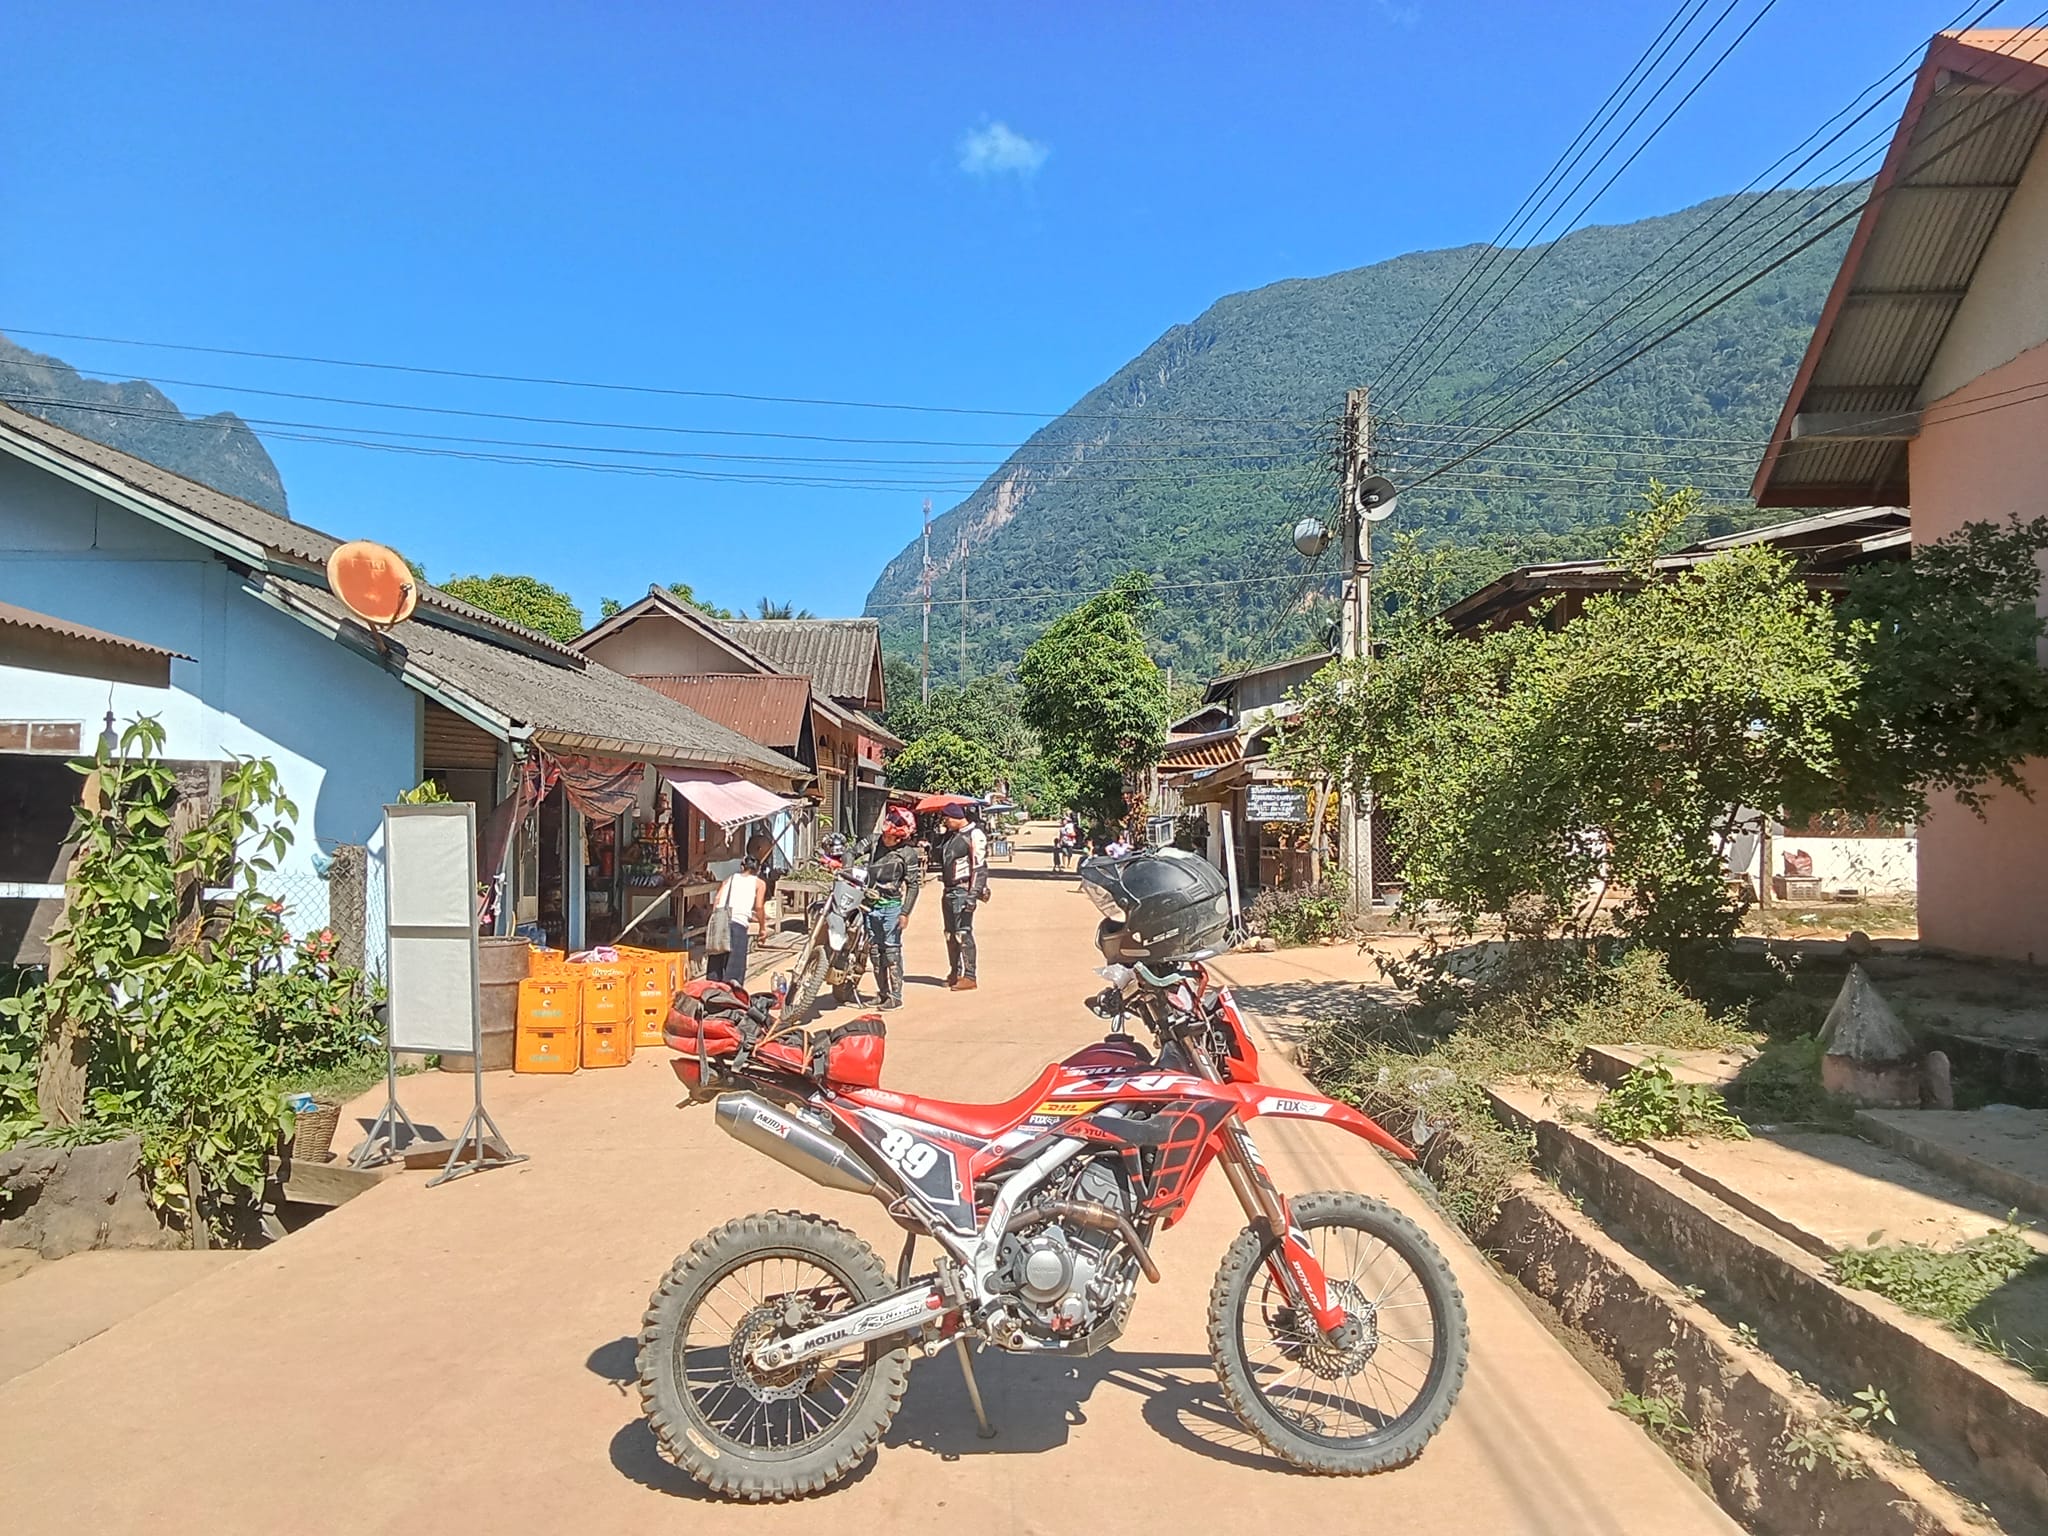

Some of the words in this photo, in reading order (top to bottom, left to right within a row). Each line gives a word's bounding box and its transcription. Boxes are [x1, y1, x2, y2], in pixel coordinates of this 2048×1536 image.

[1051, 1075, 1203, 1095] CRF
[1047, 1104, 1079, 1112] DHL
[1276, 1100, 1300, 1112] FOX
[1029, 1115, 1046, 1124] FOX
[880, 1128, 938, 1179] 89
[1292, 1260, 1322, 1311] DUNLOP
[803, 1329, 849, 1350] MOTUL
